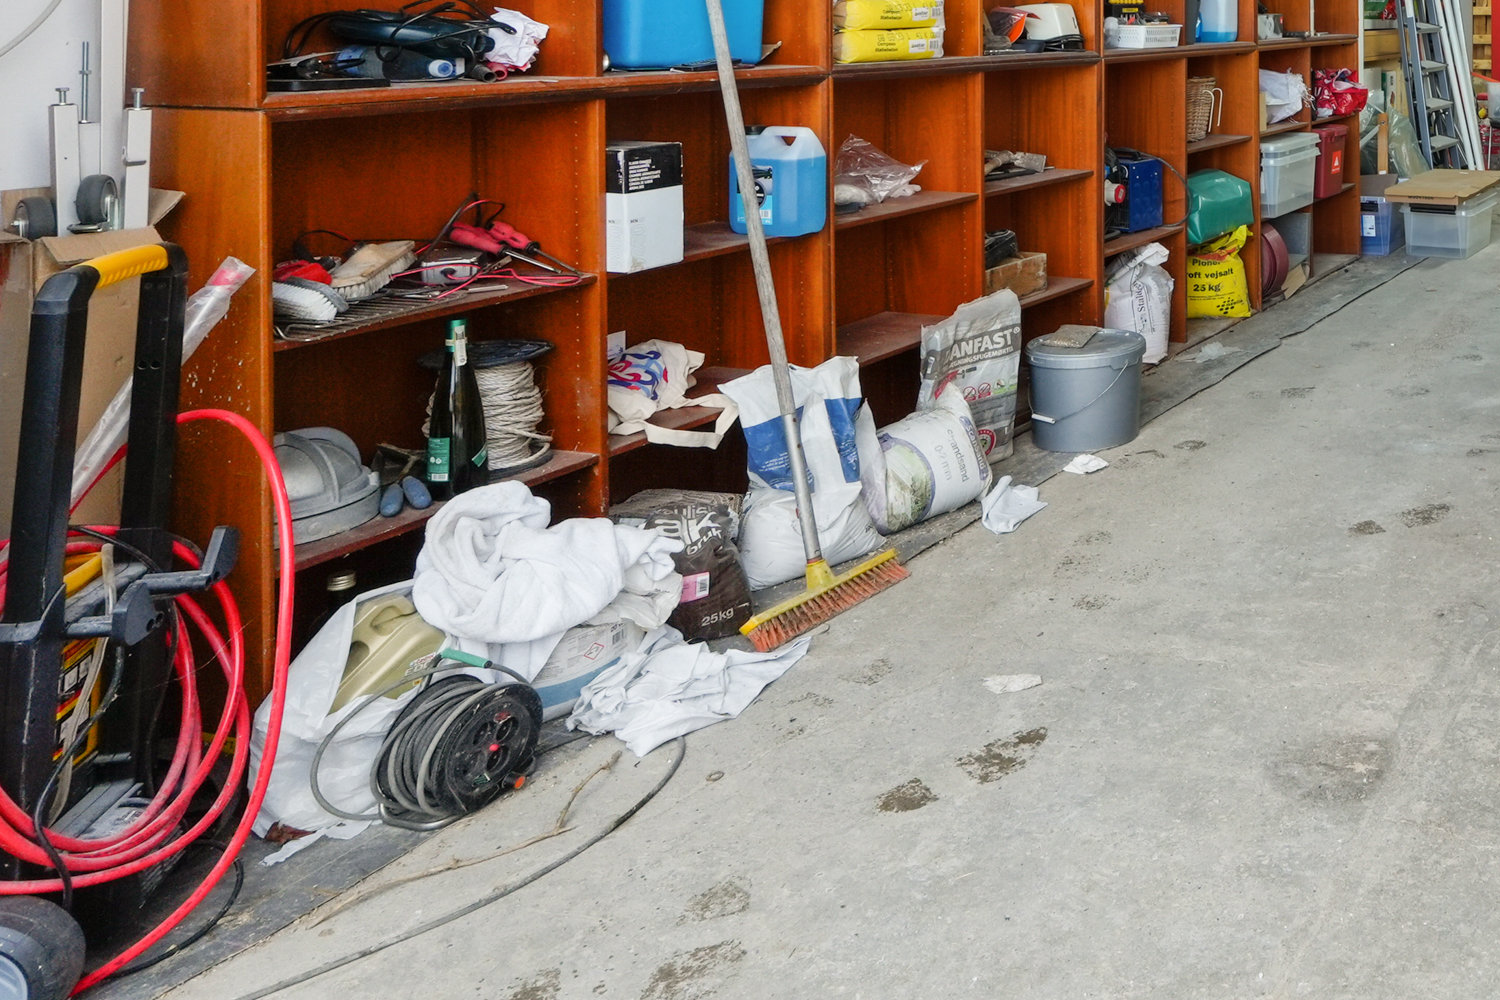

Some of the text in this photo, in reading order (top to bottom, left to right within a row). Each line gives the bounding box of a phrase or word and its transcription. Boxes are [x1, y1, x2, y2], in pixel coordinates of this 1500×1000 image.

[1205, 268, 1234, 279] vejsalt
[1193, 284, 1221, 292] 25 kg
